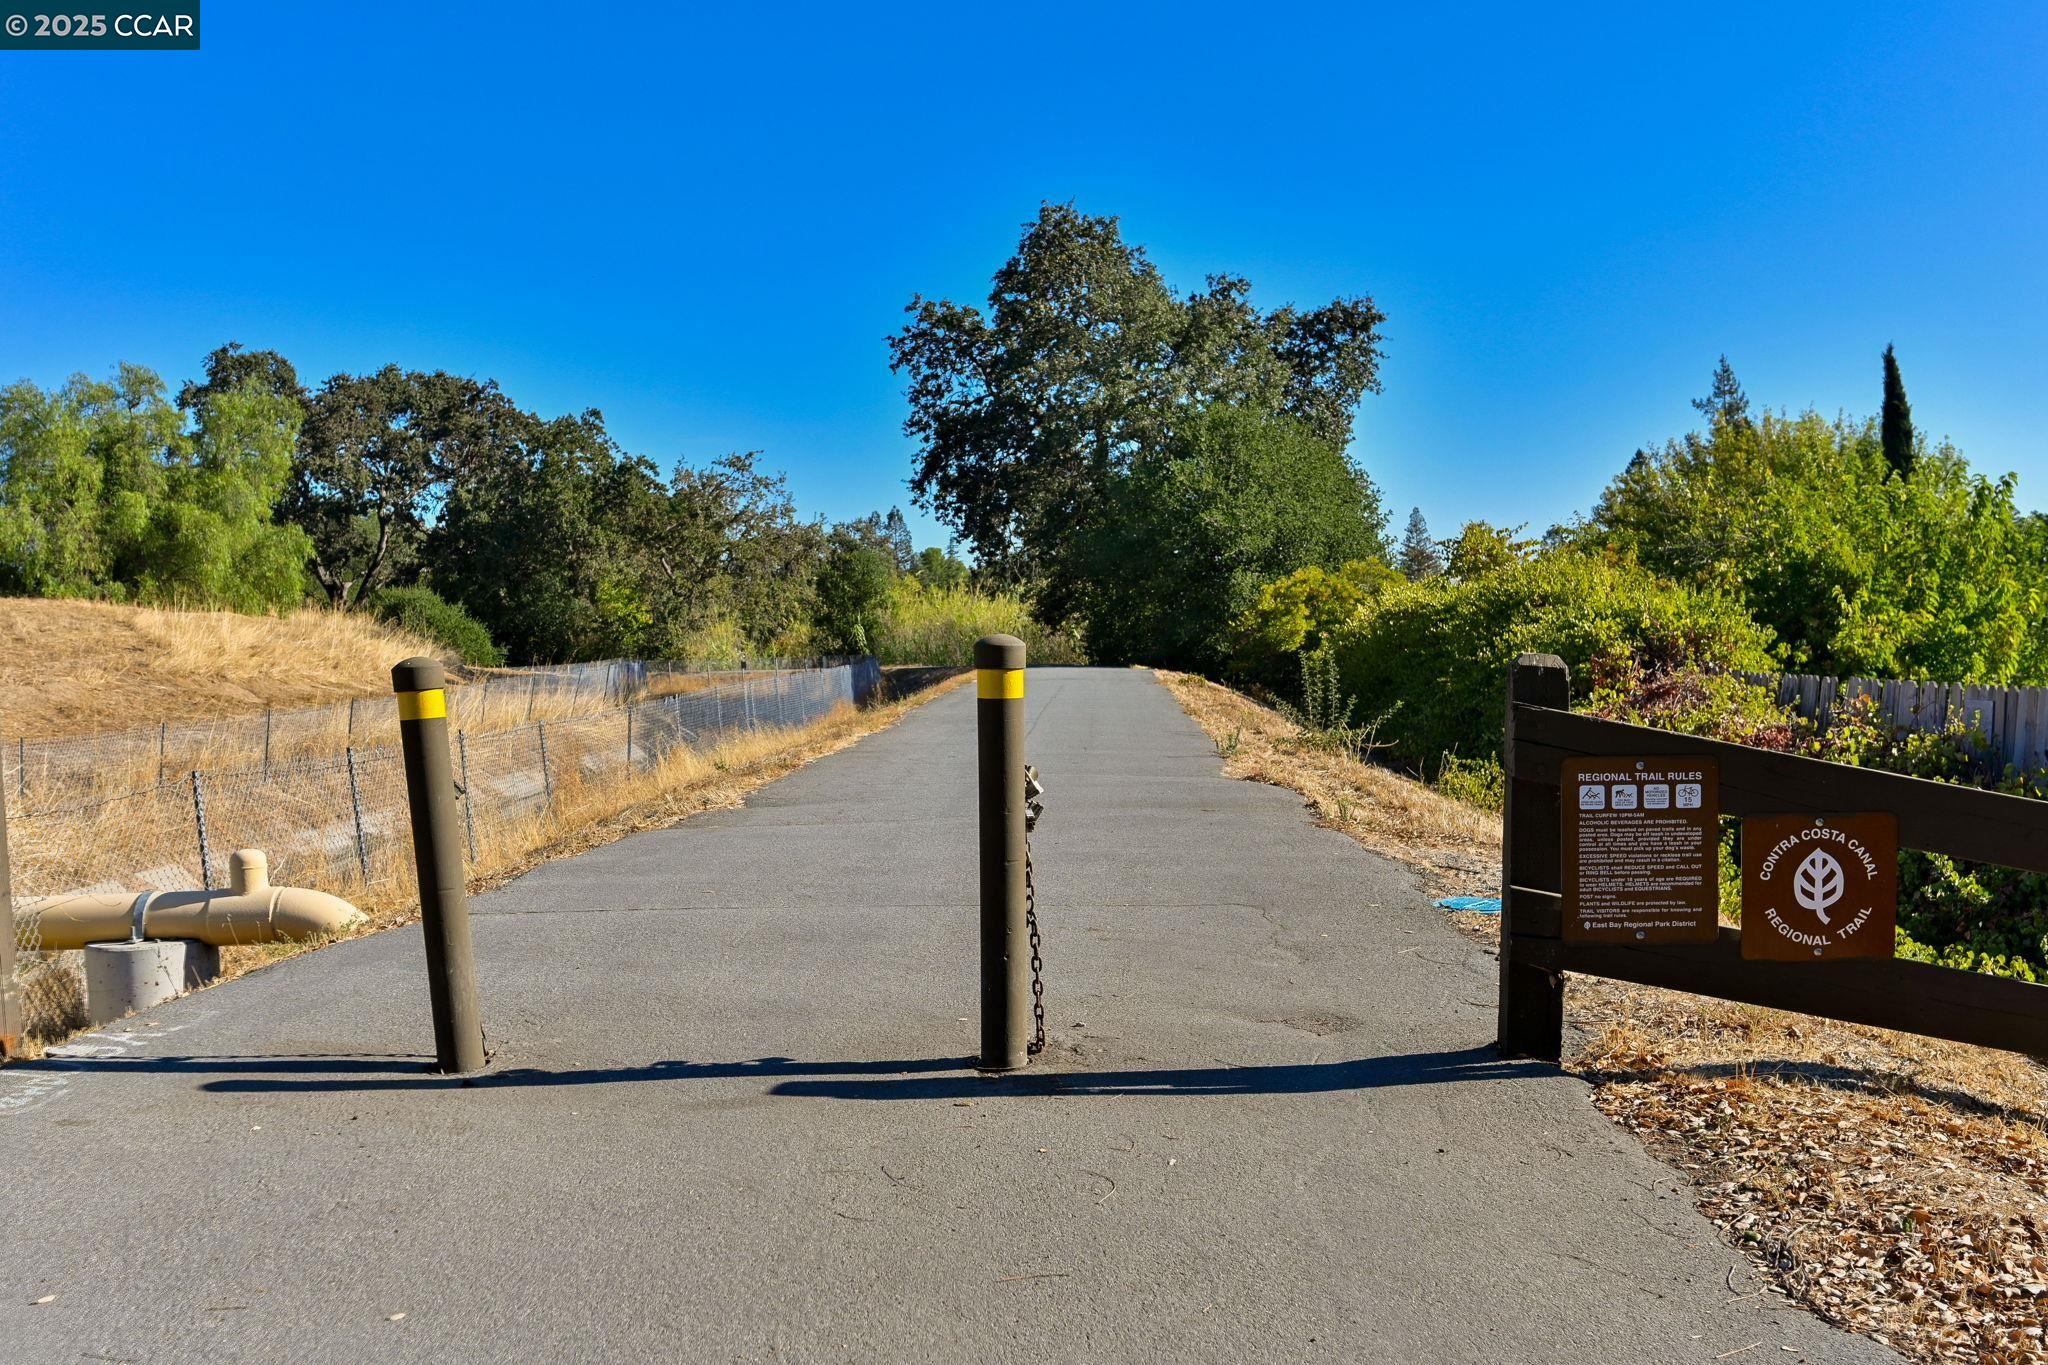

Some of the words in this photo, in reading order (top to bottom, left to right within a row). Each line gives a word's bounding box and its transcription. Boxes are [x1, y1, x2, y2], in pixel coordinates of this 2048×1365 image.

[1578, 773, 1632, 781] REGIONAL
[1634, 772, 1665, 780] TRAIL
[1668, 771, 1702, 780] RULES
[1760, 834, 1800, 880] CONTRA
[1801, 828, 1846, 844] COSTA
[1848, 839, 1878, 880] CANAL
[1764, 907, 1831, 946] REGIONAL
[1836, 906, 1872, 939] TRAIL
